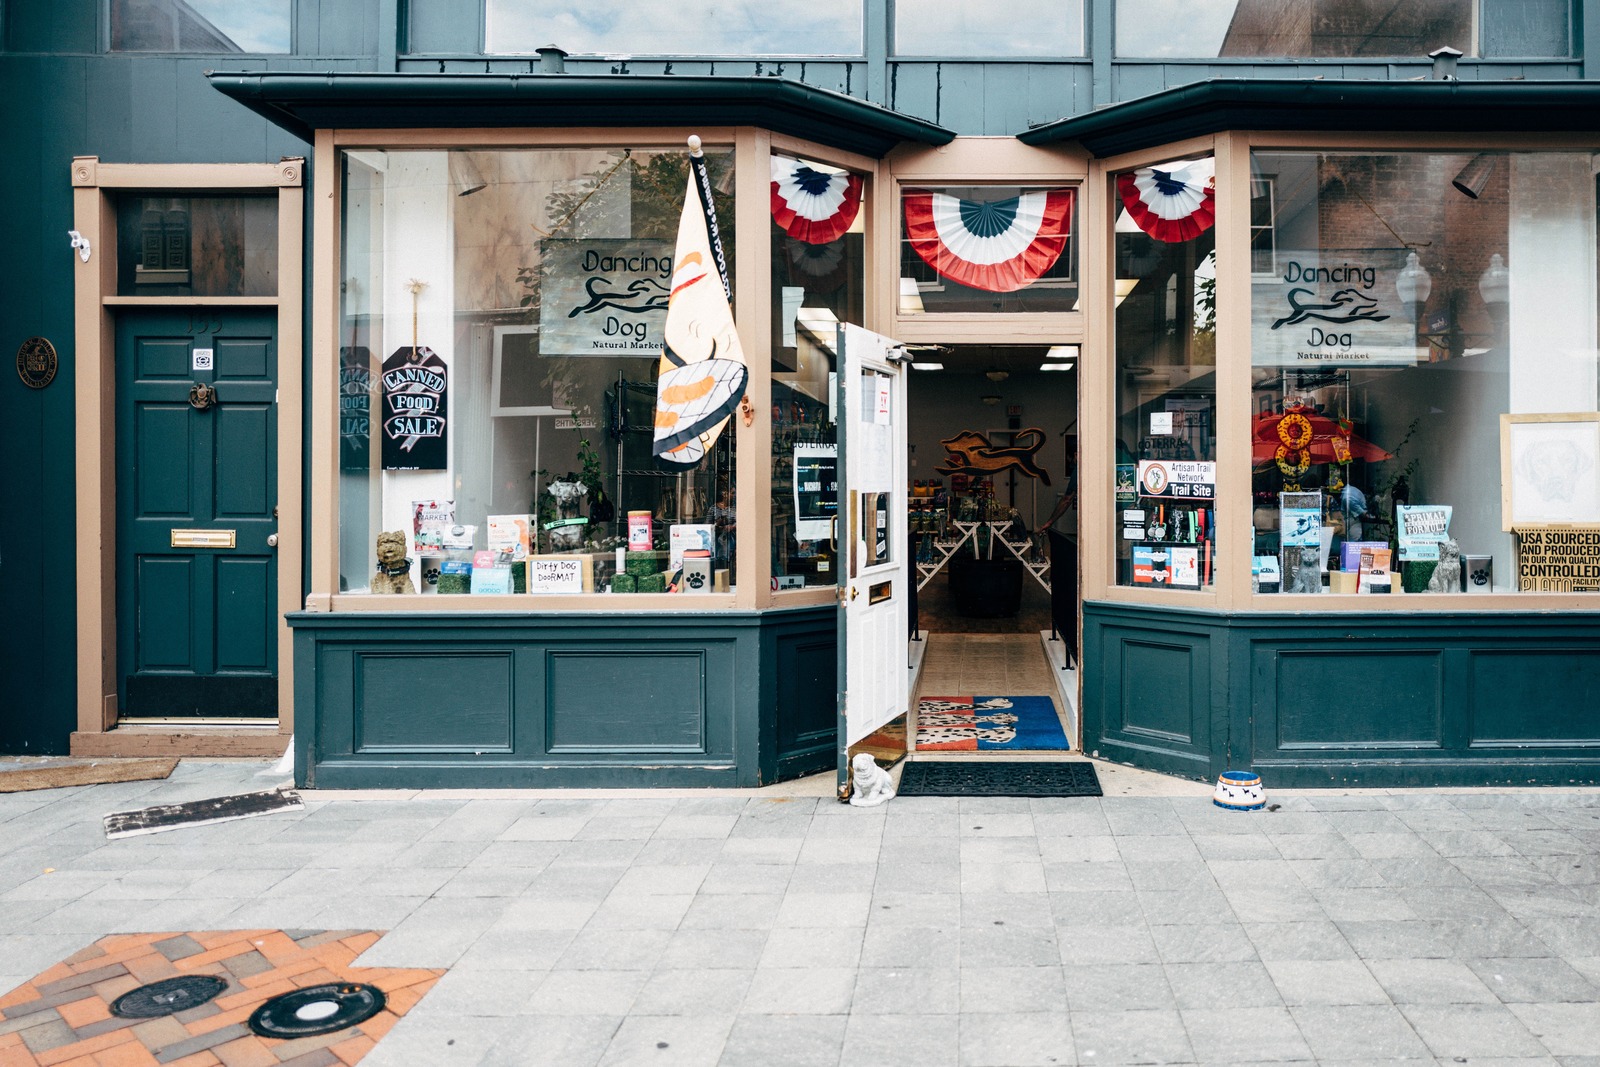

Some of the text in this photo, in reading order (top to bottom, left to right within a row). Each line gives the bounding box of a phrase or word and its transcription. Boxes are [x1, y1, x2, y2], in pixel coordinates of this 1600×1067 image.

[697, 164, 716, 216] Summer
[581, 249, 672, 279] Dancing
[1283, 261, 1376, 290] Dancing
[602, 316, 647, 342] Dog
[592, 340, 664, 350] Natural Market
[1306, 327, 1353, 353] Dog
[1297, 351, 1371, 361] Natural Market
[385, 368, 445, 392] CANNED
[396, 395, 433, 410] FOOD
[394, 417, 438, 435] SALE
[1171, 462, 1212, 473] Artisan Trail
[1177, 473, 1205, 483] Network
[1170, 483, 1212, 497] Trail Site
[1409, 510, 1446, 522] PRIMAL
[1521, 532, 1600, 545] USA SOURCED
[1521, 545, 1600, 556] AND PRODUCED
[1521, 555, 1600, 565] IN OUR OWN QUALITY
[536, 562, 559, 573] Dirty
[1521, 564, 1600, 578] CONTROLLED
[1573, 578, 1600, 586] FACILITY
